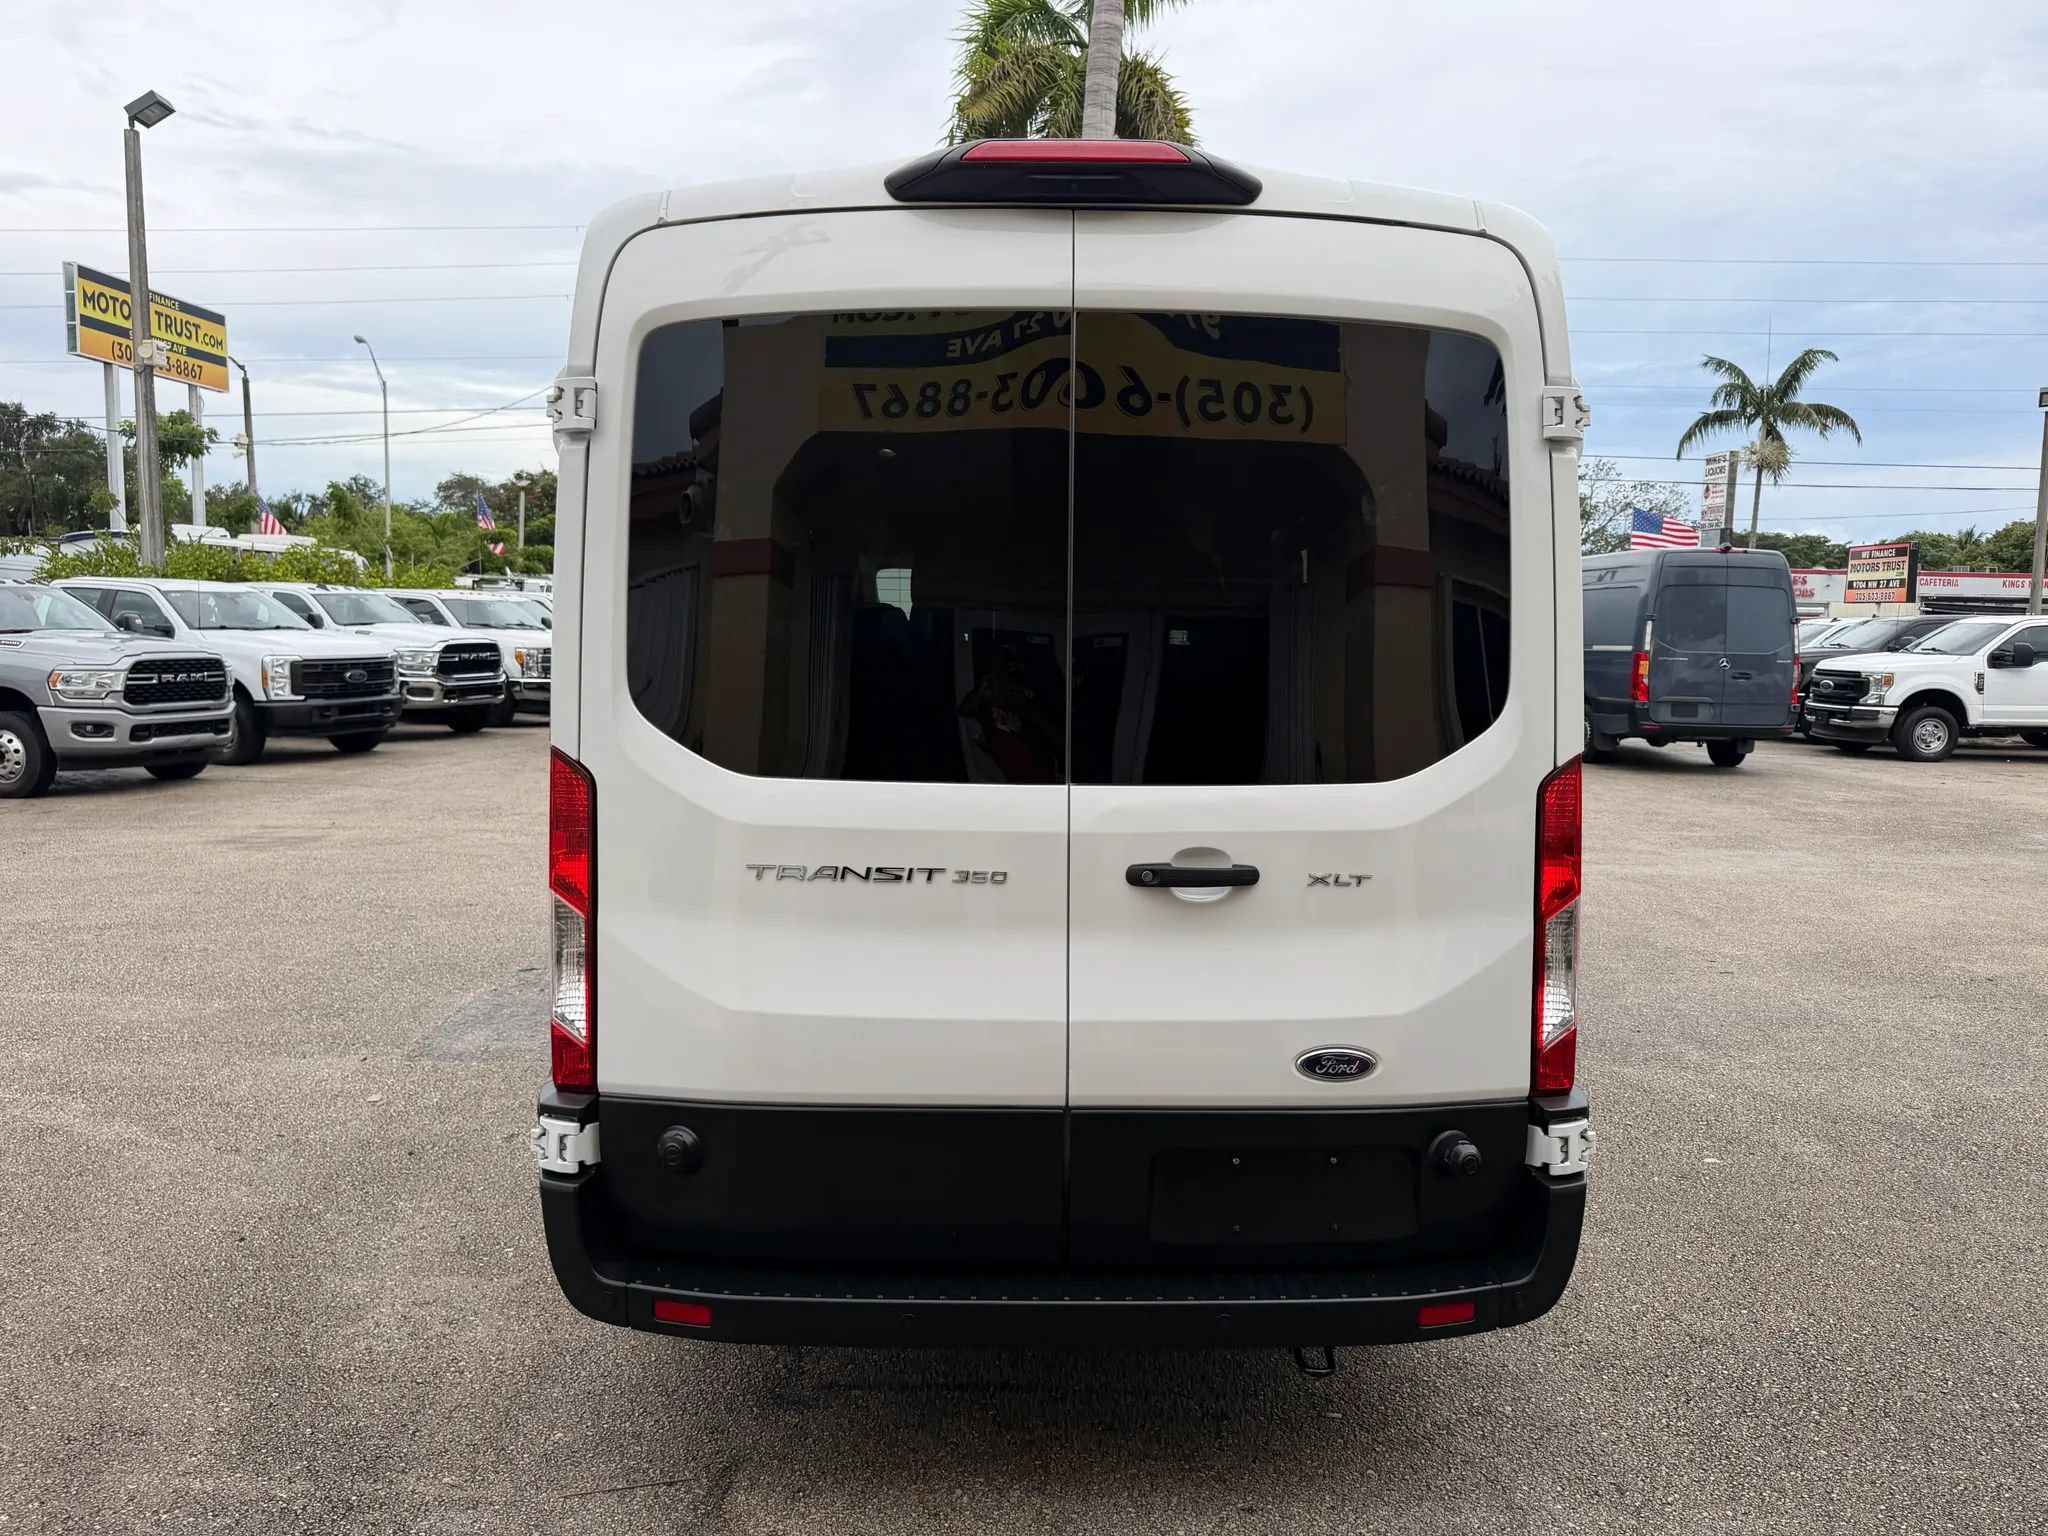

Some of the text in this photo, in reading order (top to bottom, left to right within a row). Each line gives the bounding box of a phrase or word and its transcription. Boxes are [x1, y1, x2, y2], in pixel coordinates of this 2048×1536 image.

[82, 286, 131, 320] MOTO
[149, 292, 180, 311] FINANCE
[172, 347, 188, 356] AVE
[1861, 548, 1896, 559] WE FINANCE
[1850, 560, 1906, 574] MOTORS TRUST
[1793, 575, 1808, 586] E'S
[1852, 579, 1900, 589] 9704 NW 27 AVE
[1919, 578, 1959, 588] CAFETERIA
[2002, 579, 2026, 589] KINGS
[160, 672, 207, 682] RAM
[746, 864, 1009, 885] TRANSIT 350
[1307, 873, 1375, 887] XLT
[1315, 1055, 1360, 1075] Ford
